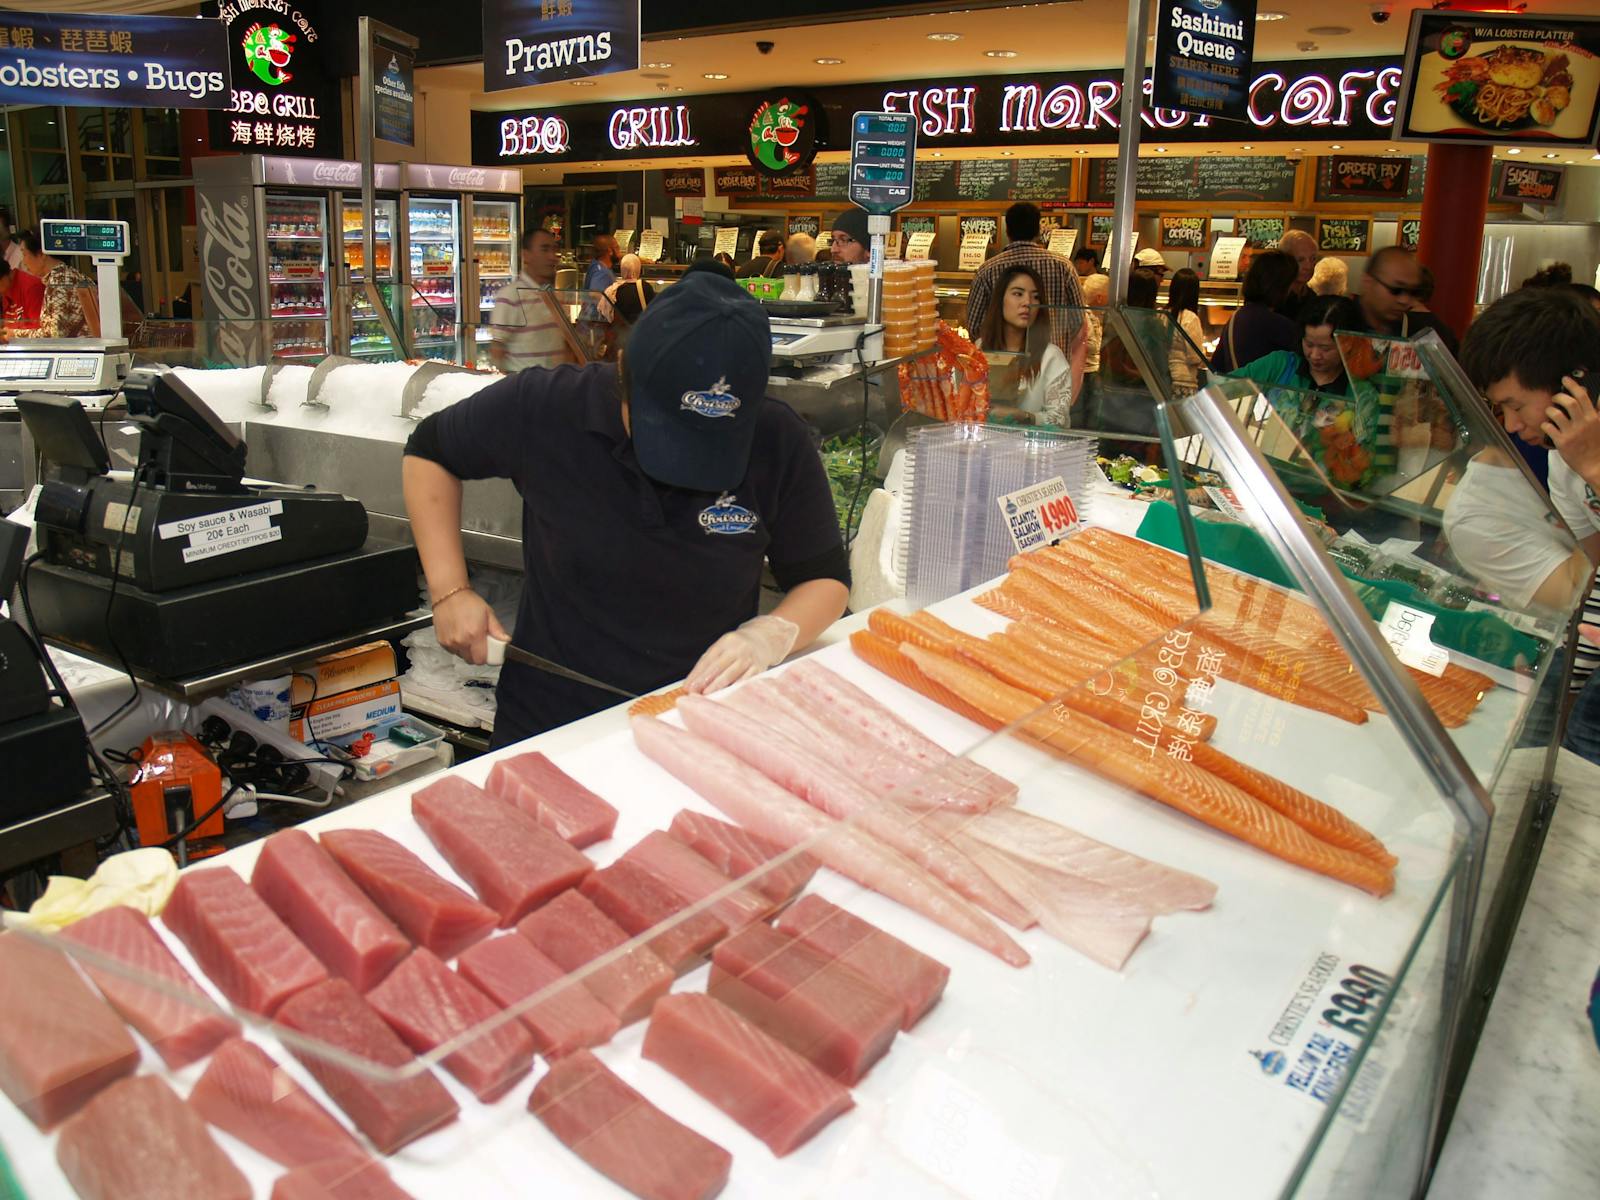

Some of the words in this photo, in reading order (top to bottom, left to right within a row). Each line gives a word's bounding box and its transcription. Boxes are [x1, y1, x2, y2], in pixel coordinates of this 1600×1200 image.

[1171, 7, 1244, 41] Sashimi
[1474, 27, 1493, 37] W/A
[1495, 28, 1535, 39] LOBSTER
[1535, 30, 1574, 41] PLATTER
[505, 30, 612, 75] Prawns
[1177, 32, 1236, 61] Queue
[1169, 55, 1209, 73] STARTS
[1211, 64, 1240, 79] HERE
[0, 59, 120, 90] obsters
[144, 63, 225, 98] Bugs
[273, 93, 321, 119] GRILL
[1000, 79, 1210, 133] MAR
[1248, 67, 1402, 127] CAFE
[231, 121, 316, 148] 海鲜烧烤
[499, 117, 567, 157] BBQ
[609, 105, 696, 150] GRILL
[313, 162, 357, 182] Coca-Cola
[448, 168, 487, 186] Coca-Cola
[1338, 161, 1377, 179] ORDER
[1381, 163, 1402, 178] PAY
[718, 175, 739, 187] ORDER
[960, 219, 998, 230] SNAPPER
[1182, 218, 1205, 229] BABY
[1168, 228, 1203, 240] OCTOPUS
[177, 522, 196, 534] Soy
[199, 517, 226, 530] sauce
[229, 512, 236, 522] &
[238, 505, 272, 519] Wasabi
[699, 512, 758, 527] Christie's
[1010, 509, 1037, 528] ATLANTIC
[207, 529, 224, 541] 20¢
[226, 524, 250, 536] Each
[1013, 521, 1041, 539] SALMON
[185, 545, 216, 559] MINIMUM
[269, 530, 280, 539] $20
[365, 705, 396, 720] MEDIUM
[1268, 989, 1314, 1047] CHRISTIE'S
[1303, 951, 1341, 1000] SEAFOODS
